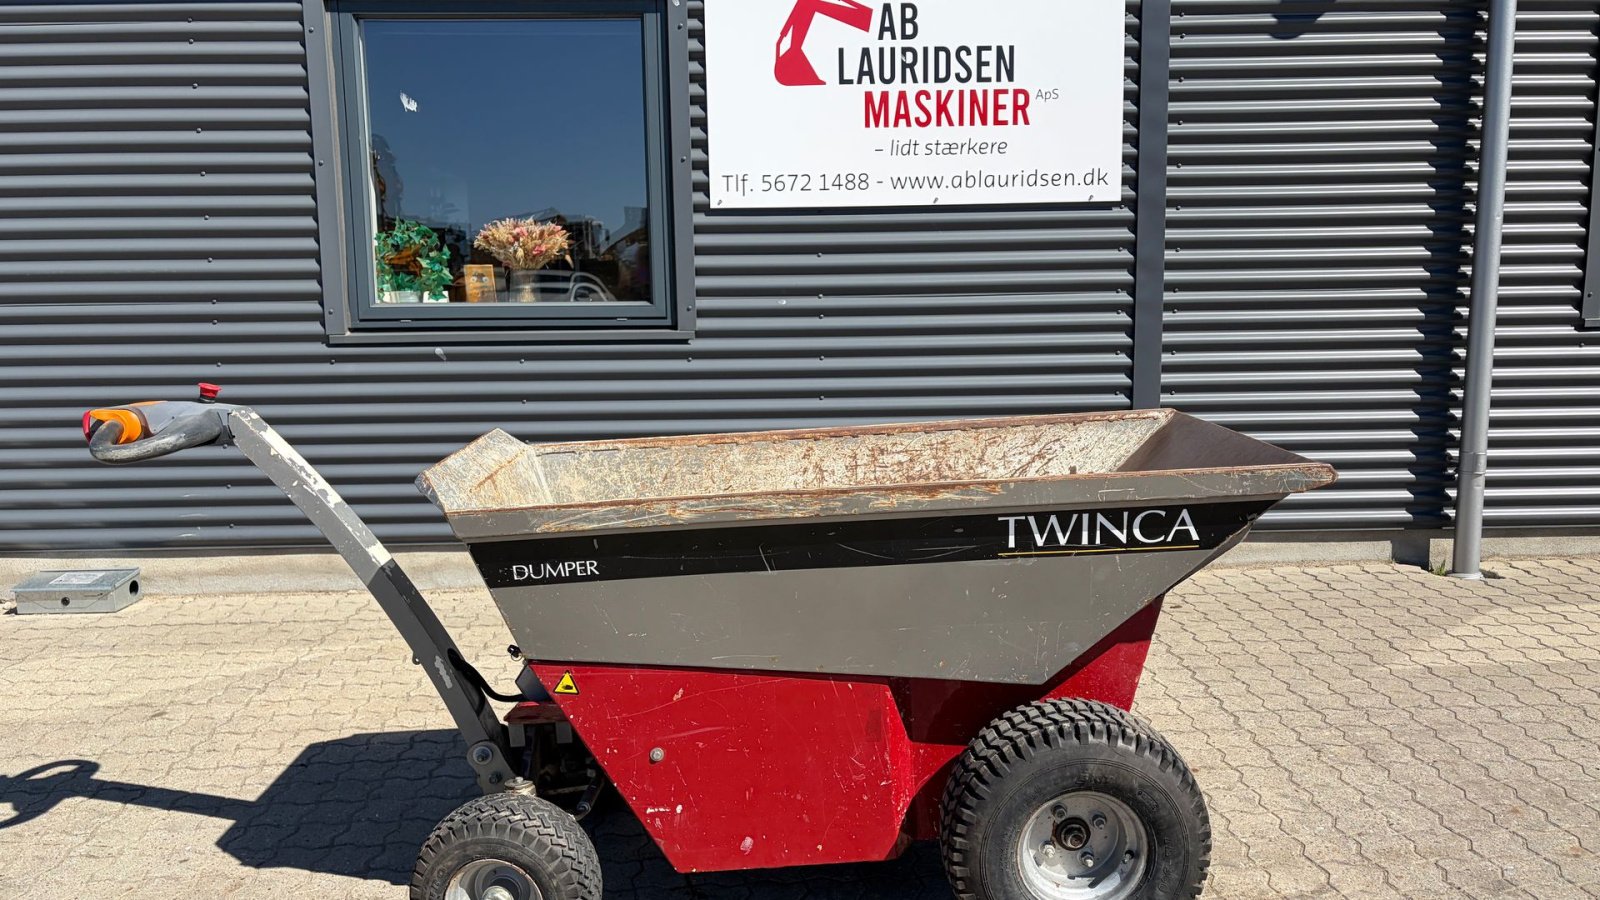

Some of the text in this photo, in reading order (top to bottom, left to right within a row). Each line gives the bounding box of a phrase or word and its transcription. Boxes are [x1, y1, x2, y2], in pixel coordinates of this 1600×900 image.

[877, 2, 919, 41] AB
[837, 44, 1015, 86] LAURIDSEN
[863, 87, 1060, 129] MASKINER ApS
[890, 138, 920, 157] lidt
[924, 137, 1008, 157] stærkere
[721, 173, 754, 197] Tlf.
[761, 173, 812, 193] 5672
[818, 172, 870, 191] 1488
[890, 167, 1109, 190] www.ablauridsen.dk
[998, 508, 1200, 548] TWINCA
[512, 560, 600, 580] DUMPER
